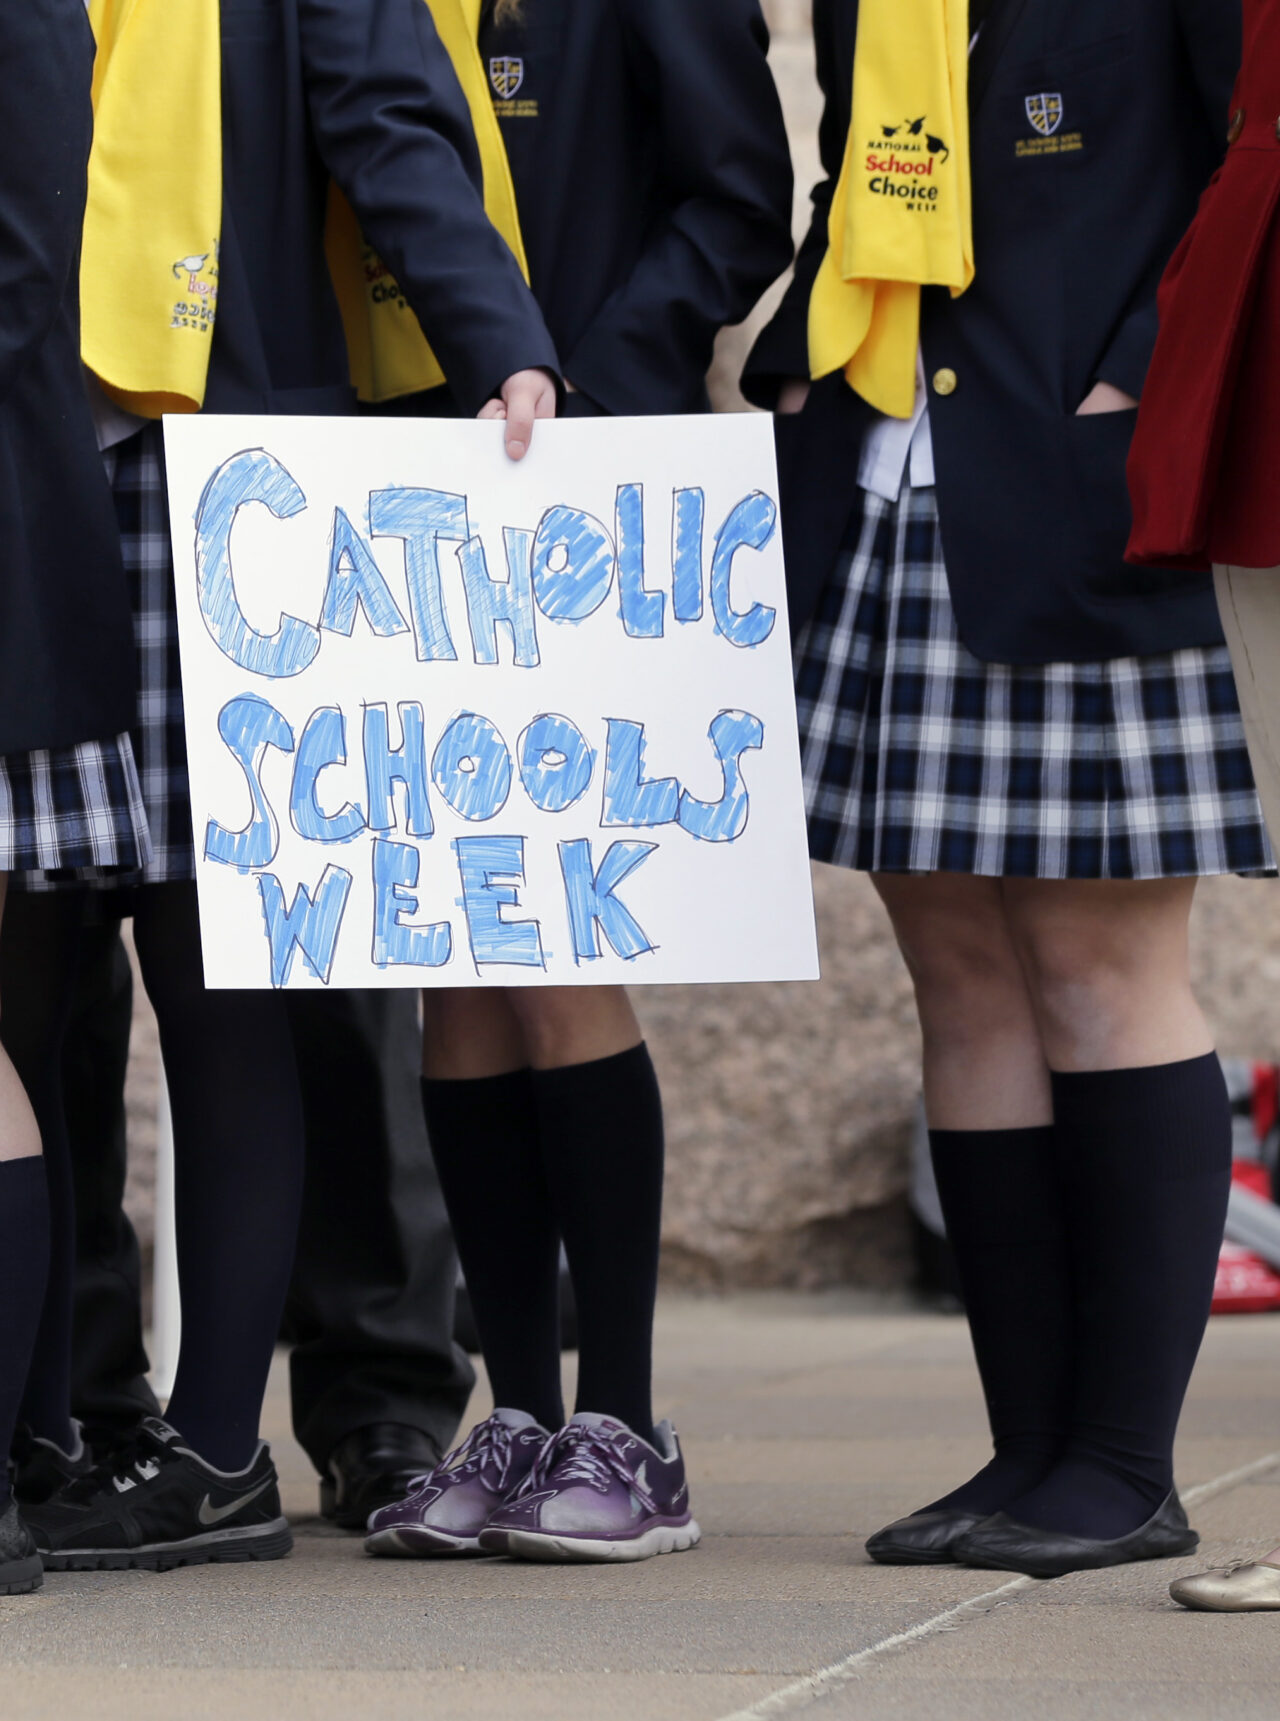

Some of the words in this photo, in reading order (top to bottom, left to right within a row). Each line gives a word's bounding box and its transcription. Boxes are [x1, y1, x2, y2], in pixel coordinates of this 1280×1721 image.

[865, 154, 933, 176] School
[867, 141, 921, 152] NATIONAL
[869, 177, 938, 201] Choice
[195, 446, 777, 679] CATHOLIC
[204, 692, 764, 874] SCHOOLS
[252, 835, 661, 988] WEEK
